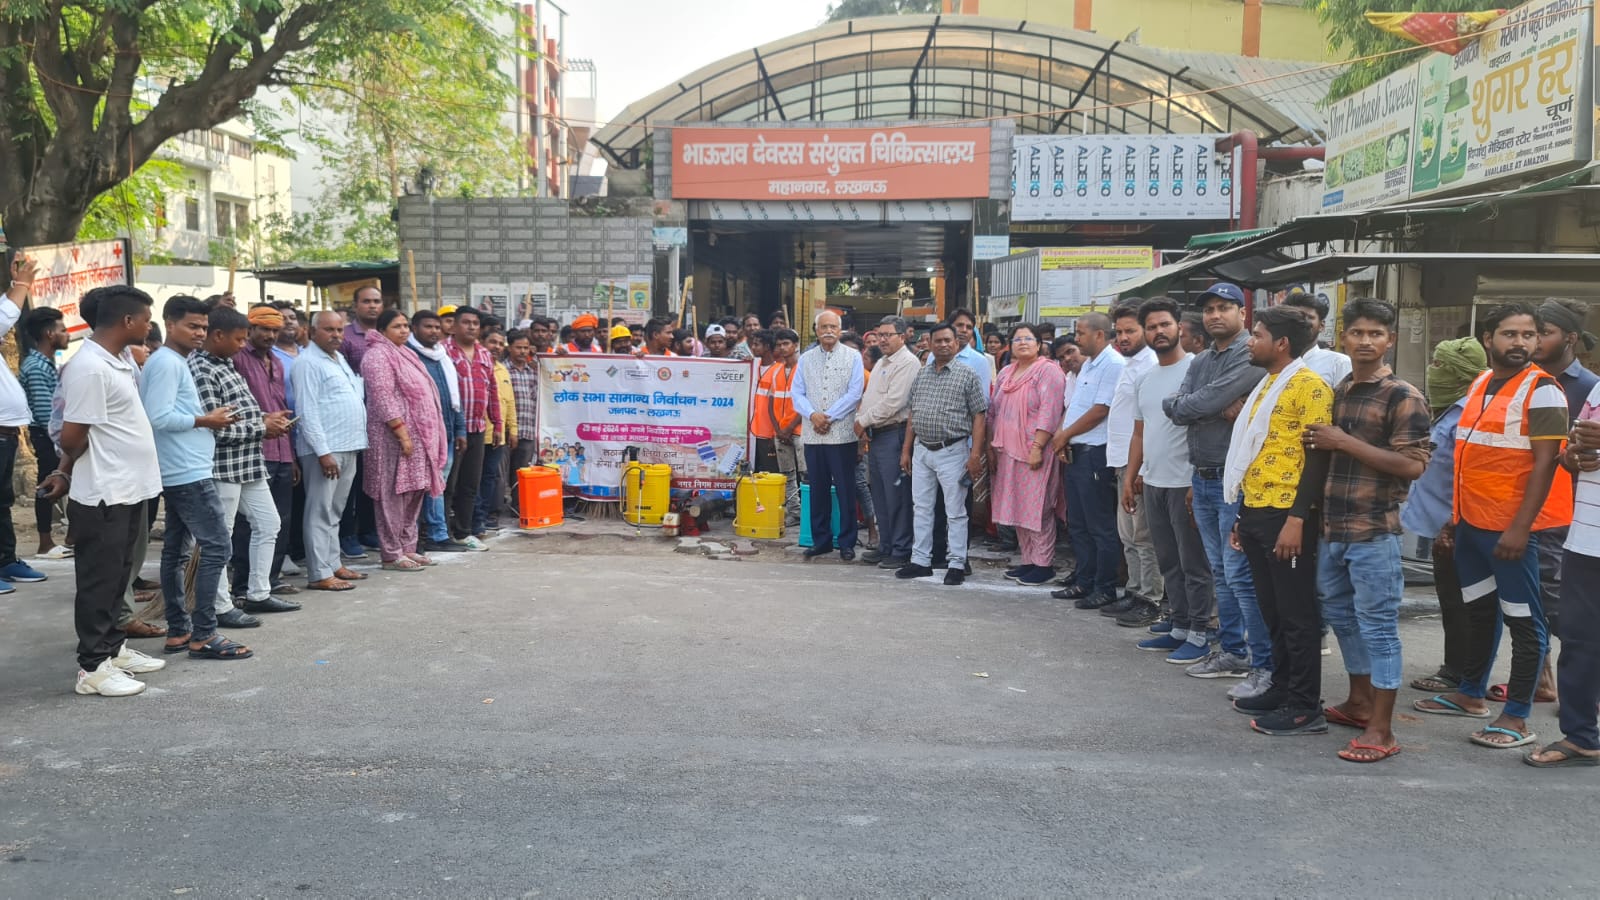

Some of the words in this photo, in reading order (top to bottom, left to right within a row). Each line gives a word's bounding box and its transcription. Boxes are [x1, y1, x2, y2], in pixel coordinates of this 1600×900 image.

[1471, 57, 1533, 144] शुगर
[1536, 38, 1577, 106] हर
[1328, 101, 1347, 140] Shri
[1345, 83, 1381, 133] Prakash
[1382, 75, 1416, 118] Sweets
[1545, 93, 1574, 121] चूर्ण
[683, 141, 748, 167] भाऊराव
[752, 136, 805, 166] देवरस
[808, 134, 866, 175] संयुक्त
[870, 132, 976, 166] चिकित्सालय
[1484, 162, 1514, 177] AVAILABLE
[1514, 160, 1522, 169] AT
[1523, 154, 1549, 168] AMAZON
[768, 180, 830, 195] महानगर,
[834, 180, 888, 194] लखनऊ
[715, 372, 745, 381] SWEEP
[553, 389, 580, 403] लोक
[582, 392, 606, 403] सभा
[609, 392, 650, 405] सामान्य
[653, 391, 697, 406] निर्वाचन
[711, 397, 734, 407] 2024
[608, 407, 637, 416] जनपद
[647, 408, 681, 418] लखनऊ
[602, 424, 619, 433] 2024
[694, 479, 712, 488] निगम
